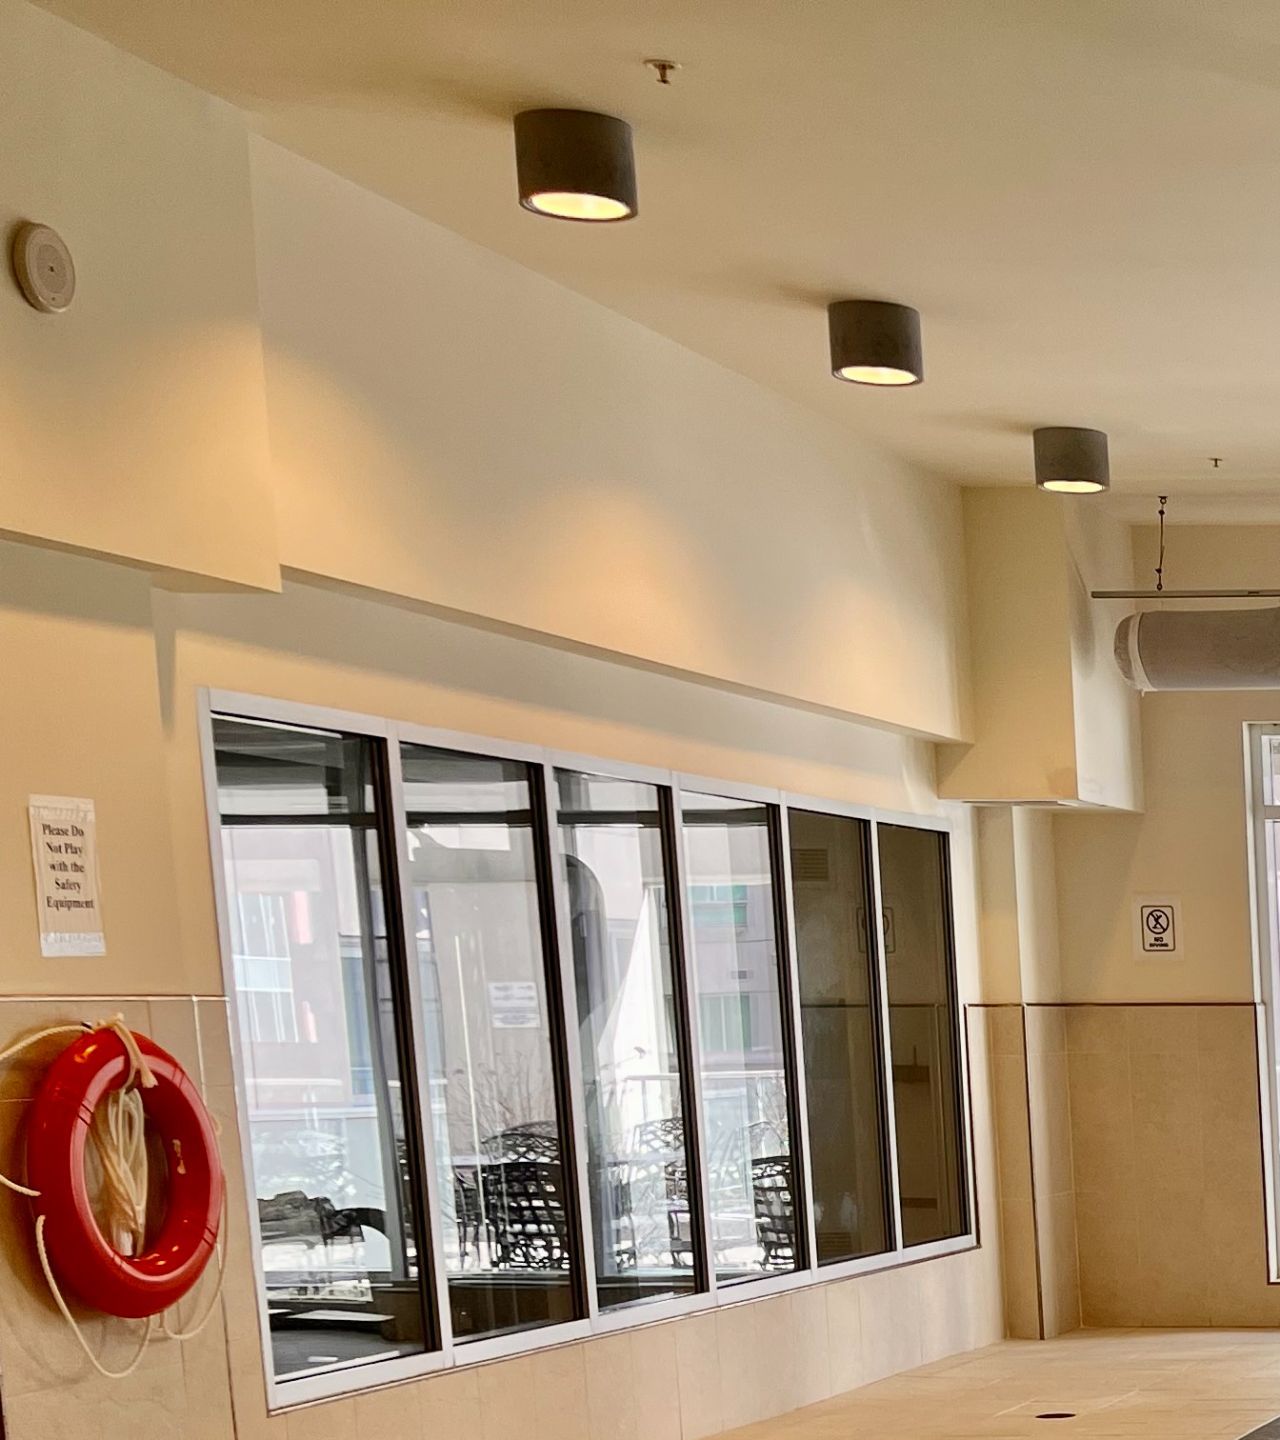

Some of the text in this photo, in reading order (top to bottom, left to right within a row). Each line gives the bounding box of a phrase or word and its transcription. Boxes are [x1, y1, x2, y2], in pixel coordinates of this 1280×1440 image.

[42, 823, 85, 838] Please Do
[46, 841, 84, 857] Not Play
[49, 861, 85, 874] with the
[54, 877, 82, 894] Safety
[46, 895, 96, 912] Equipment
